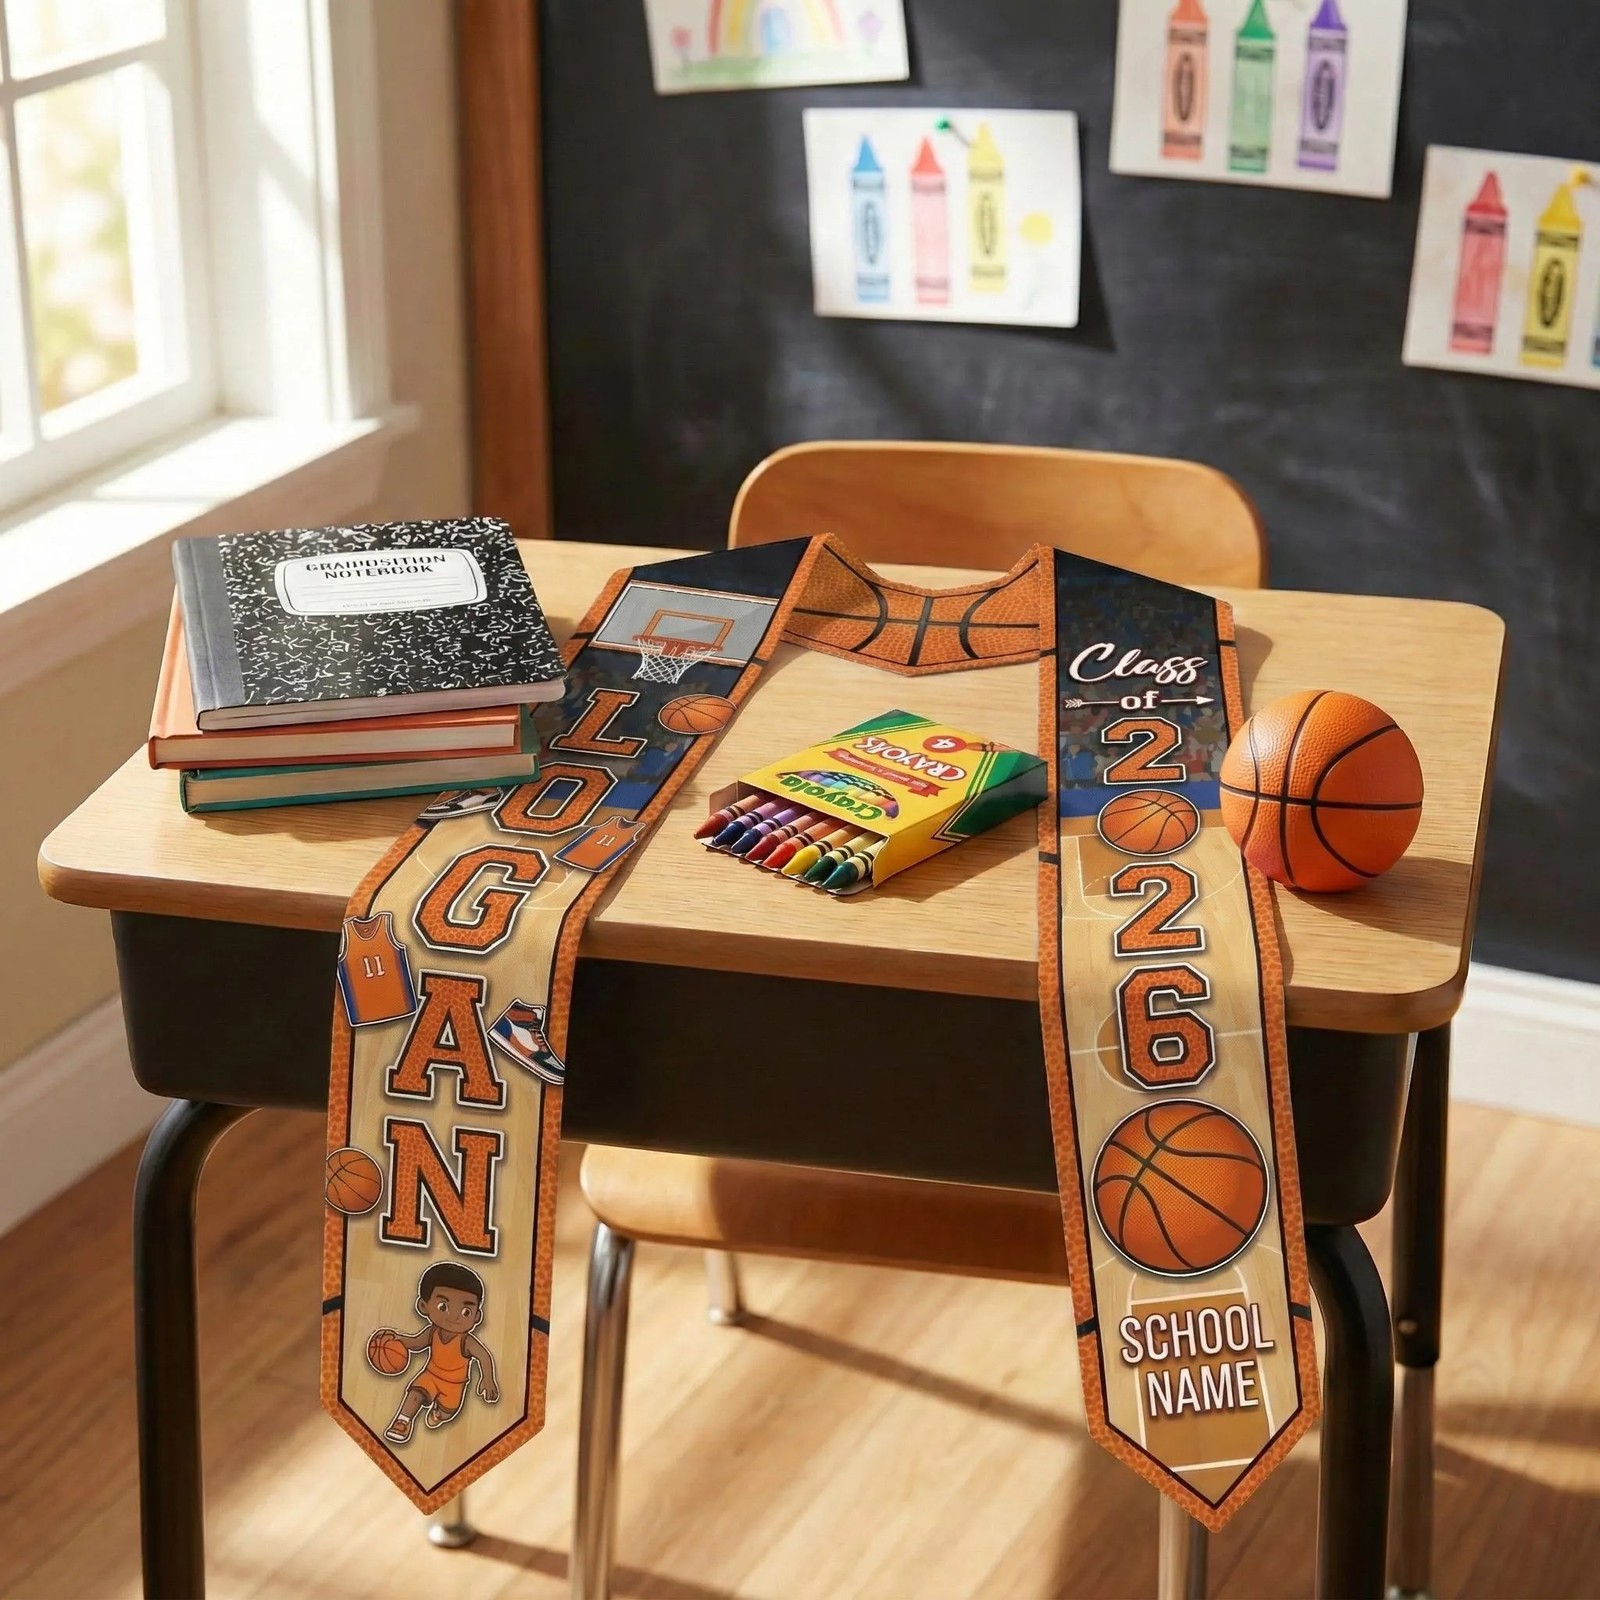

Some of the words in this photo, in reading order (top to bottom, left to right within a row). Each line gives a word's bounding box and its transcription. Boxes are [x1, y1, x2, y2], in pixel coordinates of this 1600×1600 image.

[325, 565, 434, 579] NOTEBOOK
[1069, 643, 1208, 684] Class
[1121, 691, 1159, 709] of
[931, 738, 956, 749] 4
[780, 776, 882, 820] Crayola
[596, 834, 615, 846] 11
[363, 956, 385, 978] 11
[1120, 1303, 1274, 1364] SCHOOL
[1147, 1360, 1259, 1417] NAME
